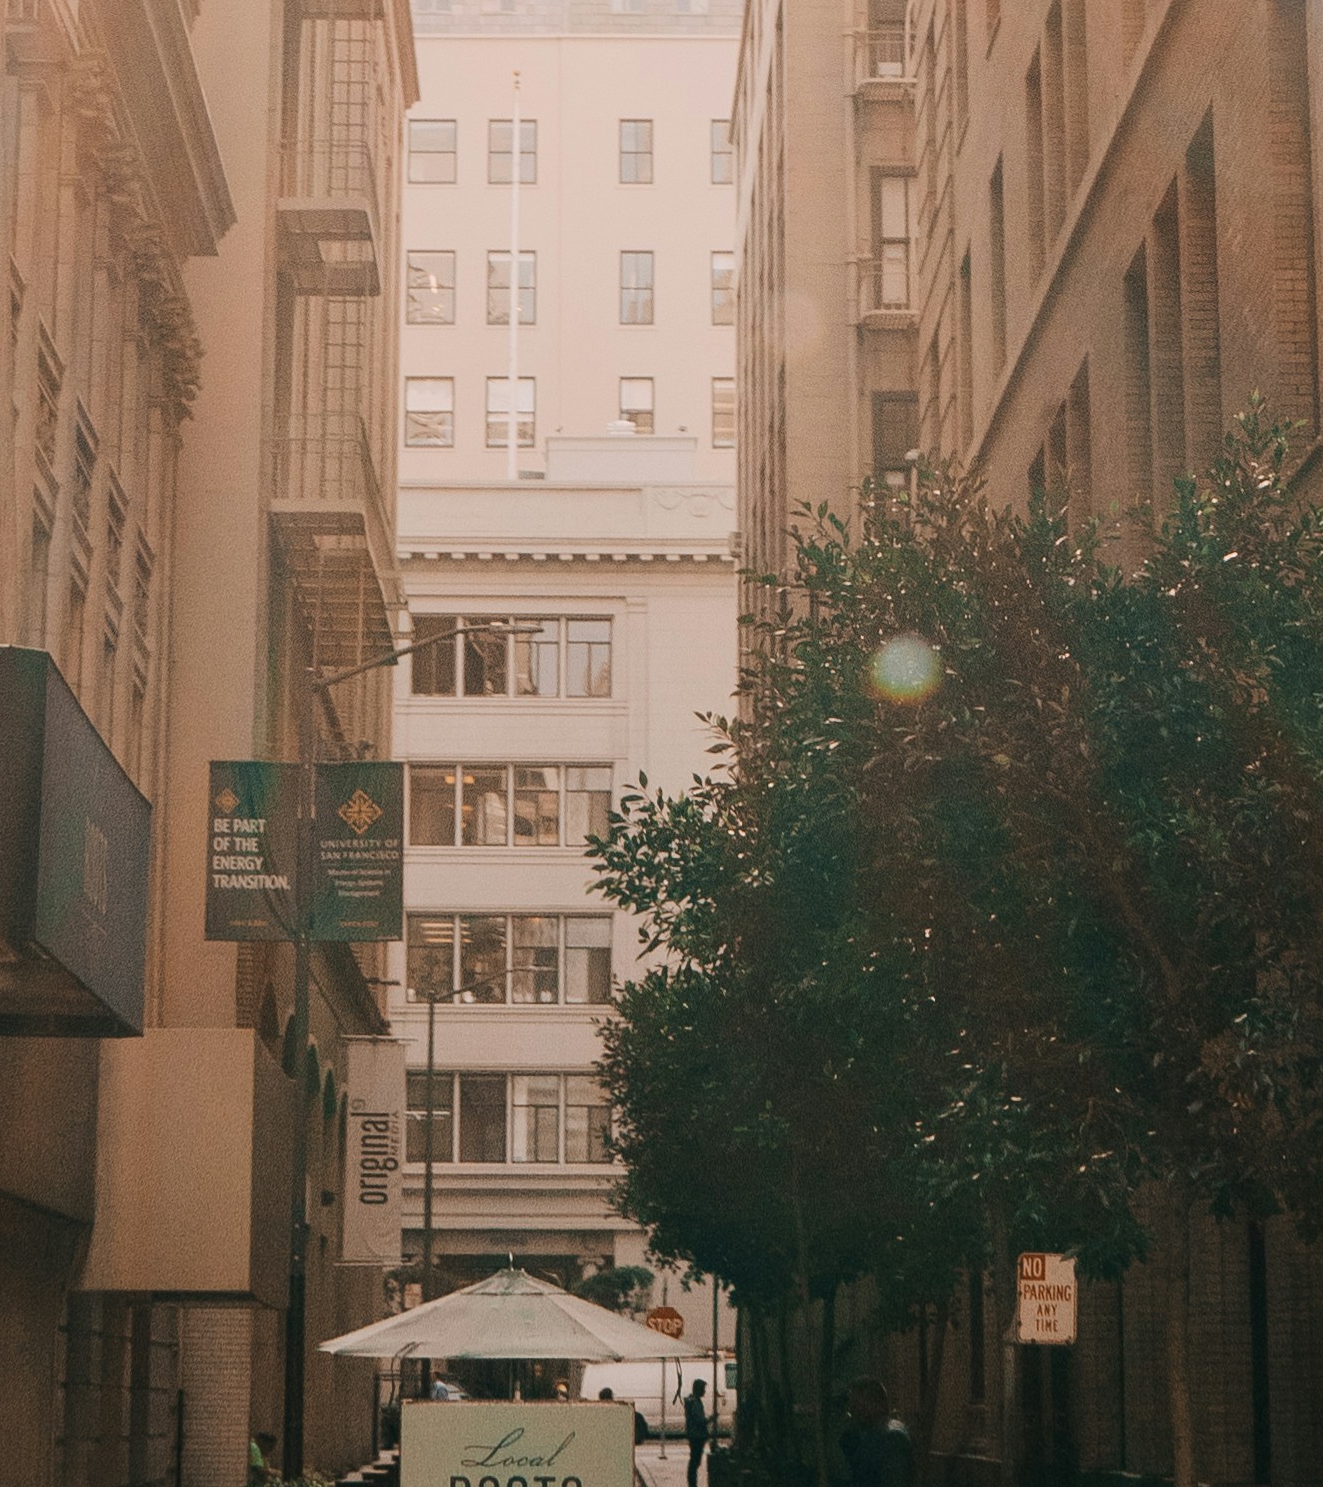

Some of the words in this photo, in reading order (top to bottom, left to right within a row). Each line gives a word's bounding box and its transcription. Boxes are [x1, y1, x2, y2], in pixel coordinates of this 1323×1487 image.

[213, 818, 230, 833] BE
[233, 819, 266, 833] PART
[213, 837, 230, 852] OF
[233, 837, 259, 852] THE
[213, 856, 263, 871] ENERGY
[212, 874, 291, 890] TRANSITION.
[350, 1111, 399, 1205] original
[1022, 1257, 1042, 1278] NO
[1023, 1284, 1071, 1301] PARKING
[1036, 1304, 1058, 1315] ANY
[648, 1317, 683, 1333] STOP
[1035, 1319, 1059, 1332] TIME
[460, 1427, 576, 1468] Local
